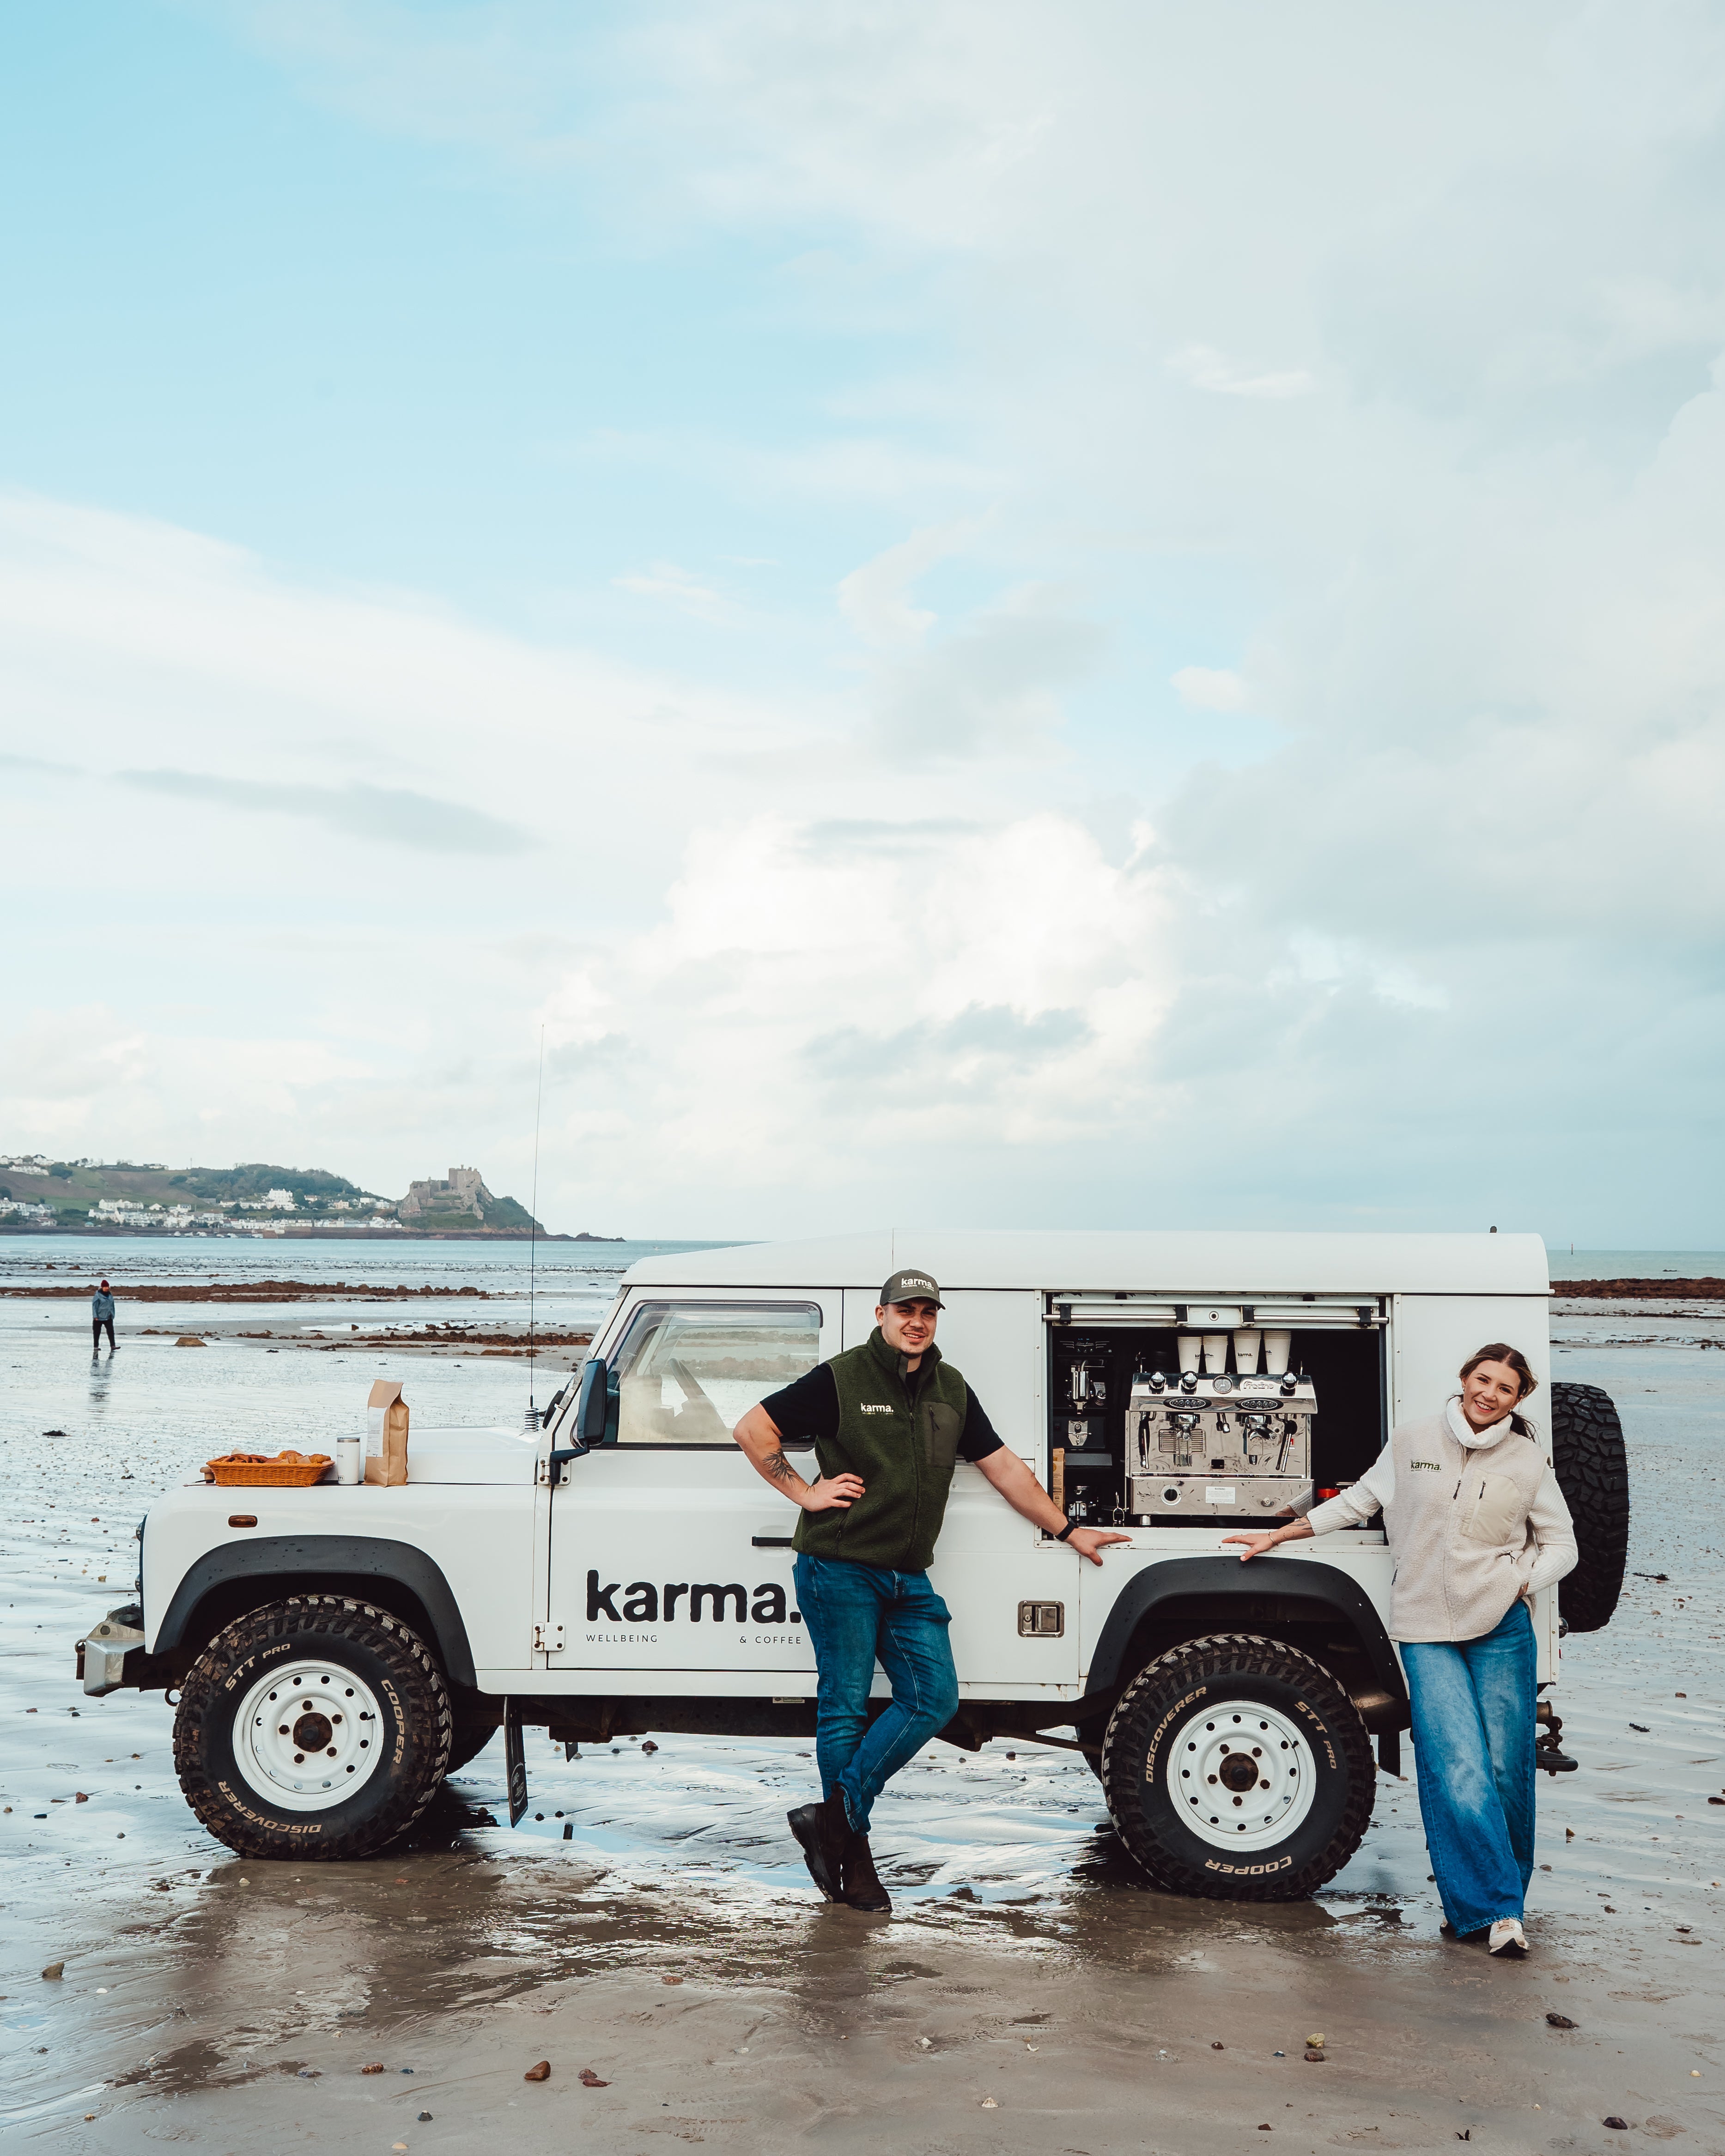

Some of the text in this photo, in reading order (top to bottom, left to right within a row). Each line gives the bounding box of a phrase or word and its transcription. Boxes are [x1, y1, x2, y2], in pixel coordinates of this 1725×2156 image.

[901, 1278, 934, 1290] karma.
[861, 1403, 894, 1412] karma.
[1411, 1460, 1441, 1471] karma.
[586, 1569, 802, 1624] karma.
[586, 1634, 658, 1643] WELLBEING
[755, 1635, 802, 1644] COFFEE
[225, 1643, 291, 1691] STT PRO
[381, 1679, 405, 1764] COOPER
[1146, 1686, 1207, 1783] DISCOVERER
[1294, 1701, 1337, 1769] STT PRO
[218, 1781, 322, 1834] DISCOVERER
[1205, 1856, 1292, 1875] COOPER
